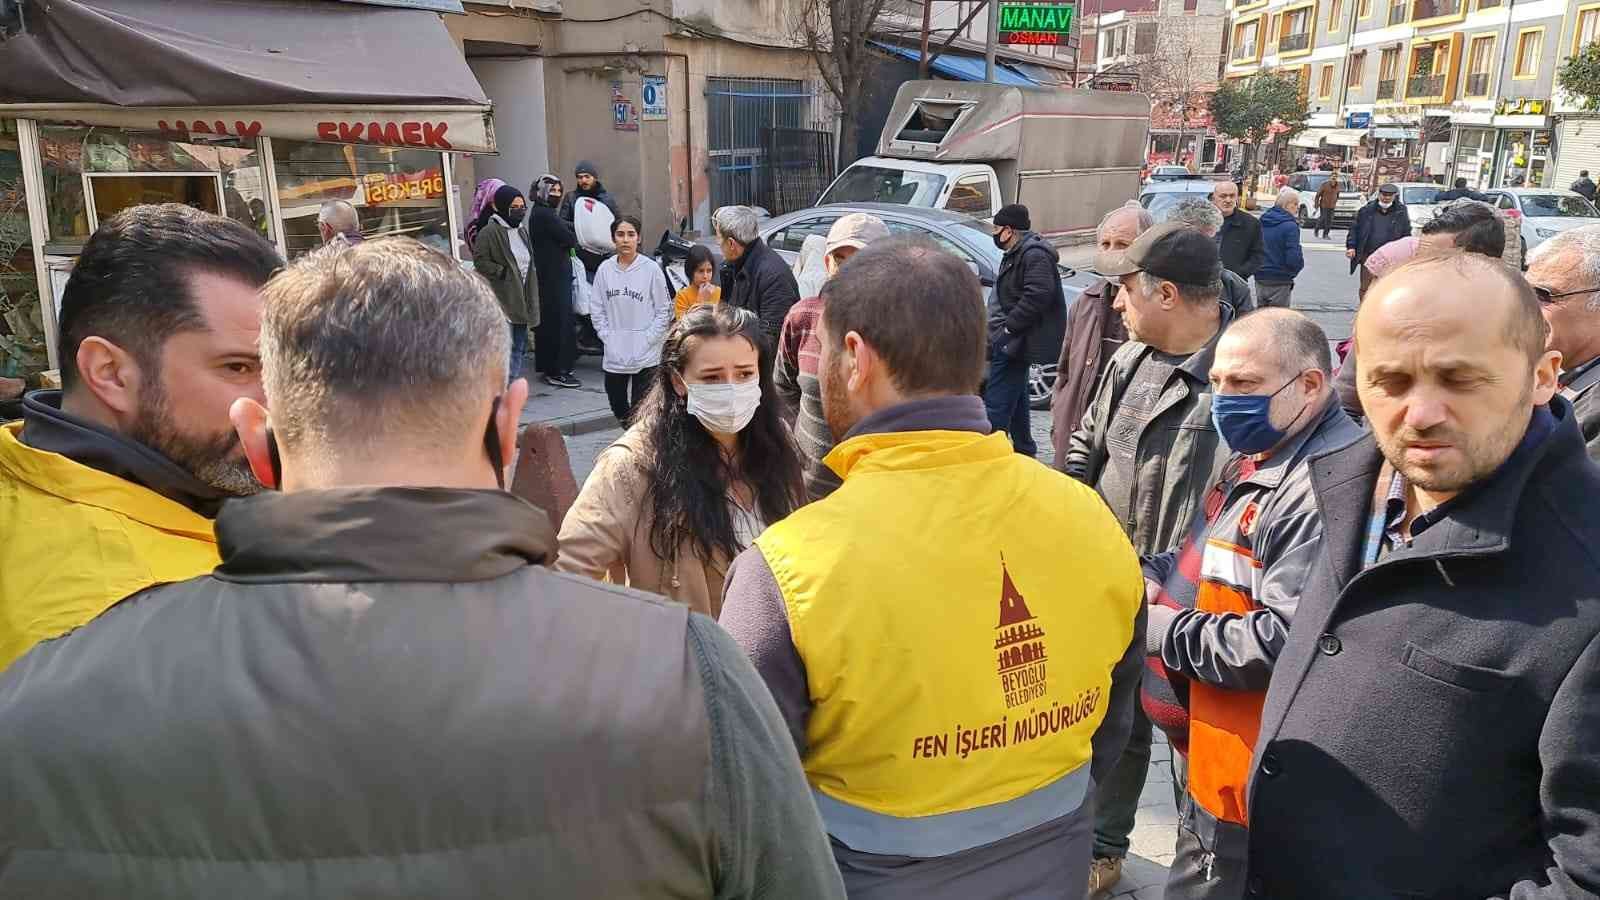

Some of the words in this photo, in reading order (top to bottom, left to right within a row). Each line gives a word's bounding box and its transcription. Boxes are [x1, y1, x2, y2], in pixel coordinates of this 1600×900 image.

[1002, 8, 1072, 28] MANAV
[1008, 31, 1057, 43] OSMAN
[316, 121, 453, 149] EKMEK
[1001, 663, 1046, 693] BEYOĞLU
[1005, 682, 1047, 709] BELEDİYESİ
[912, 733, 949, 759] FEN
[955, 715, 1008, 759] İŞLERİ
[1012, 686, 1101, 745] MÜDÜRLÜĞÜ
